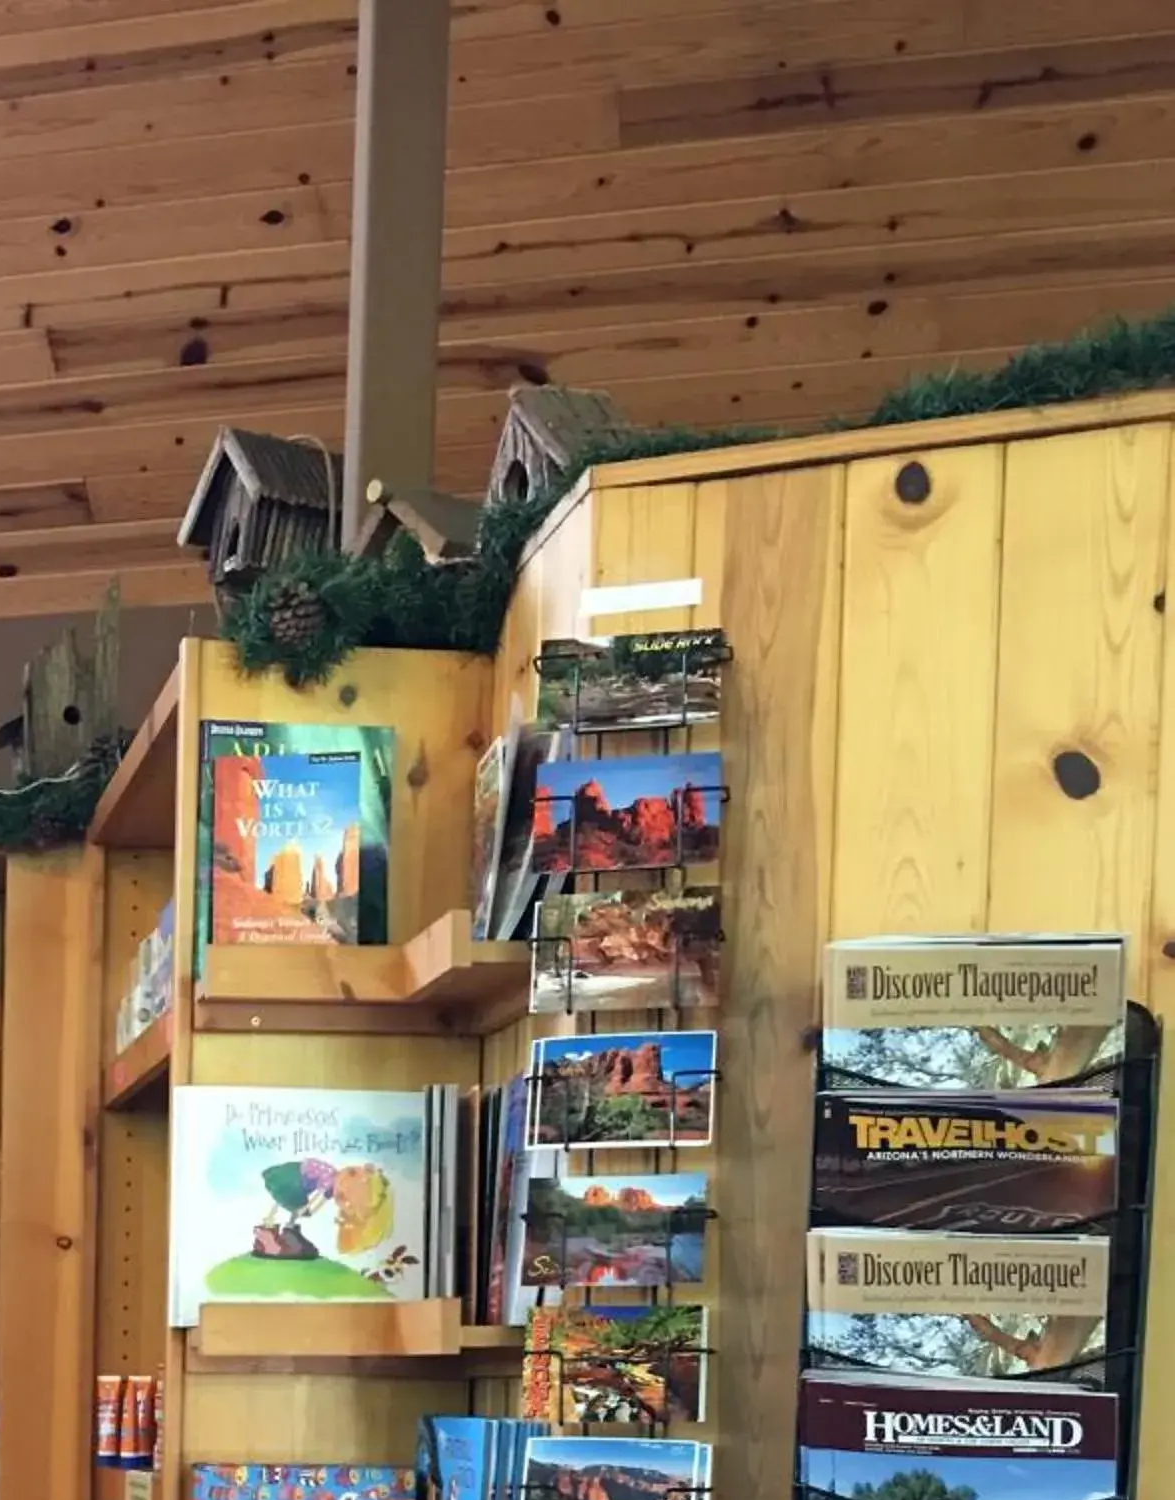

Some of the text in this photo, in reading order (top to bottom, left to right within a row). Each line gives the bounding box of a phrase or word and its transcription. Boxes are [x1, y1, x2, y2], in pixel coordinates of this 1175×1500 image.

[252, 779, 320, 799] WHAT
[265, 802, 307, 818] IS A
[871, 962, 1099, 1003] Discover Tlaquepaque!
[848, 1114, 1115, 1155] TRAVELHOST
[866, 1150, 928, 1162] ARIZONA'S
[932, 1150, 994, 1161] NORTHERN
[862, 1252, 1088, 1293] Discover Tlaquepaque!
[863, 1410, 1084, 1448] HOMES&LAND
